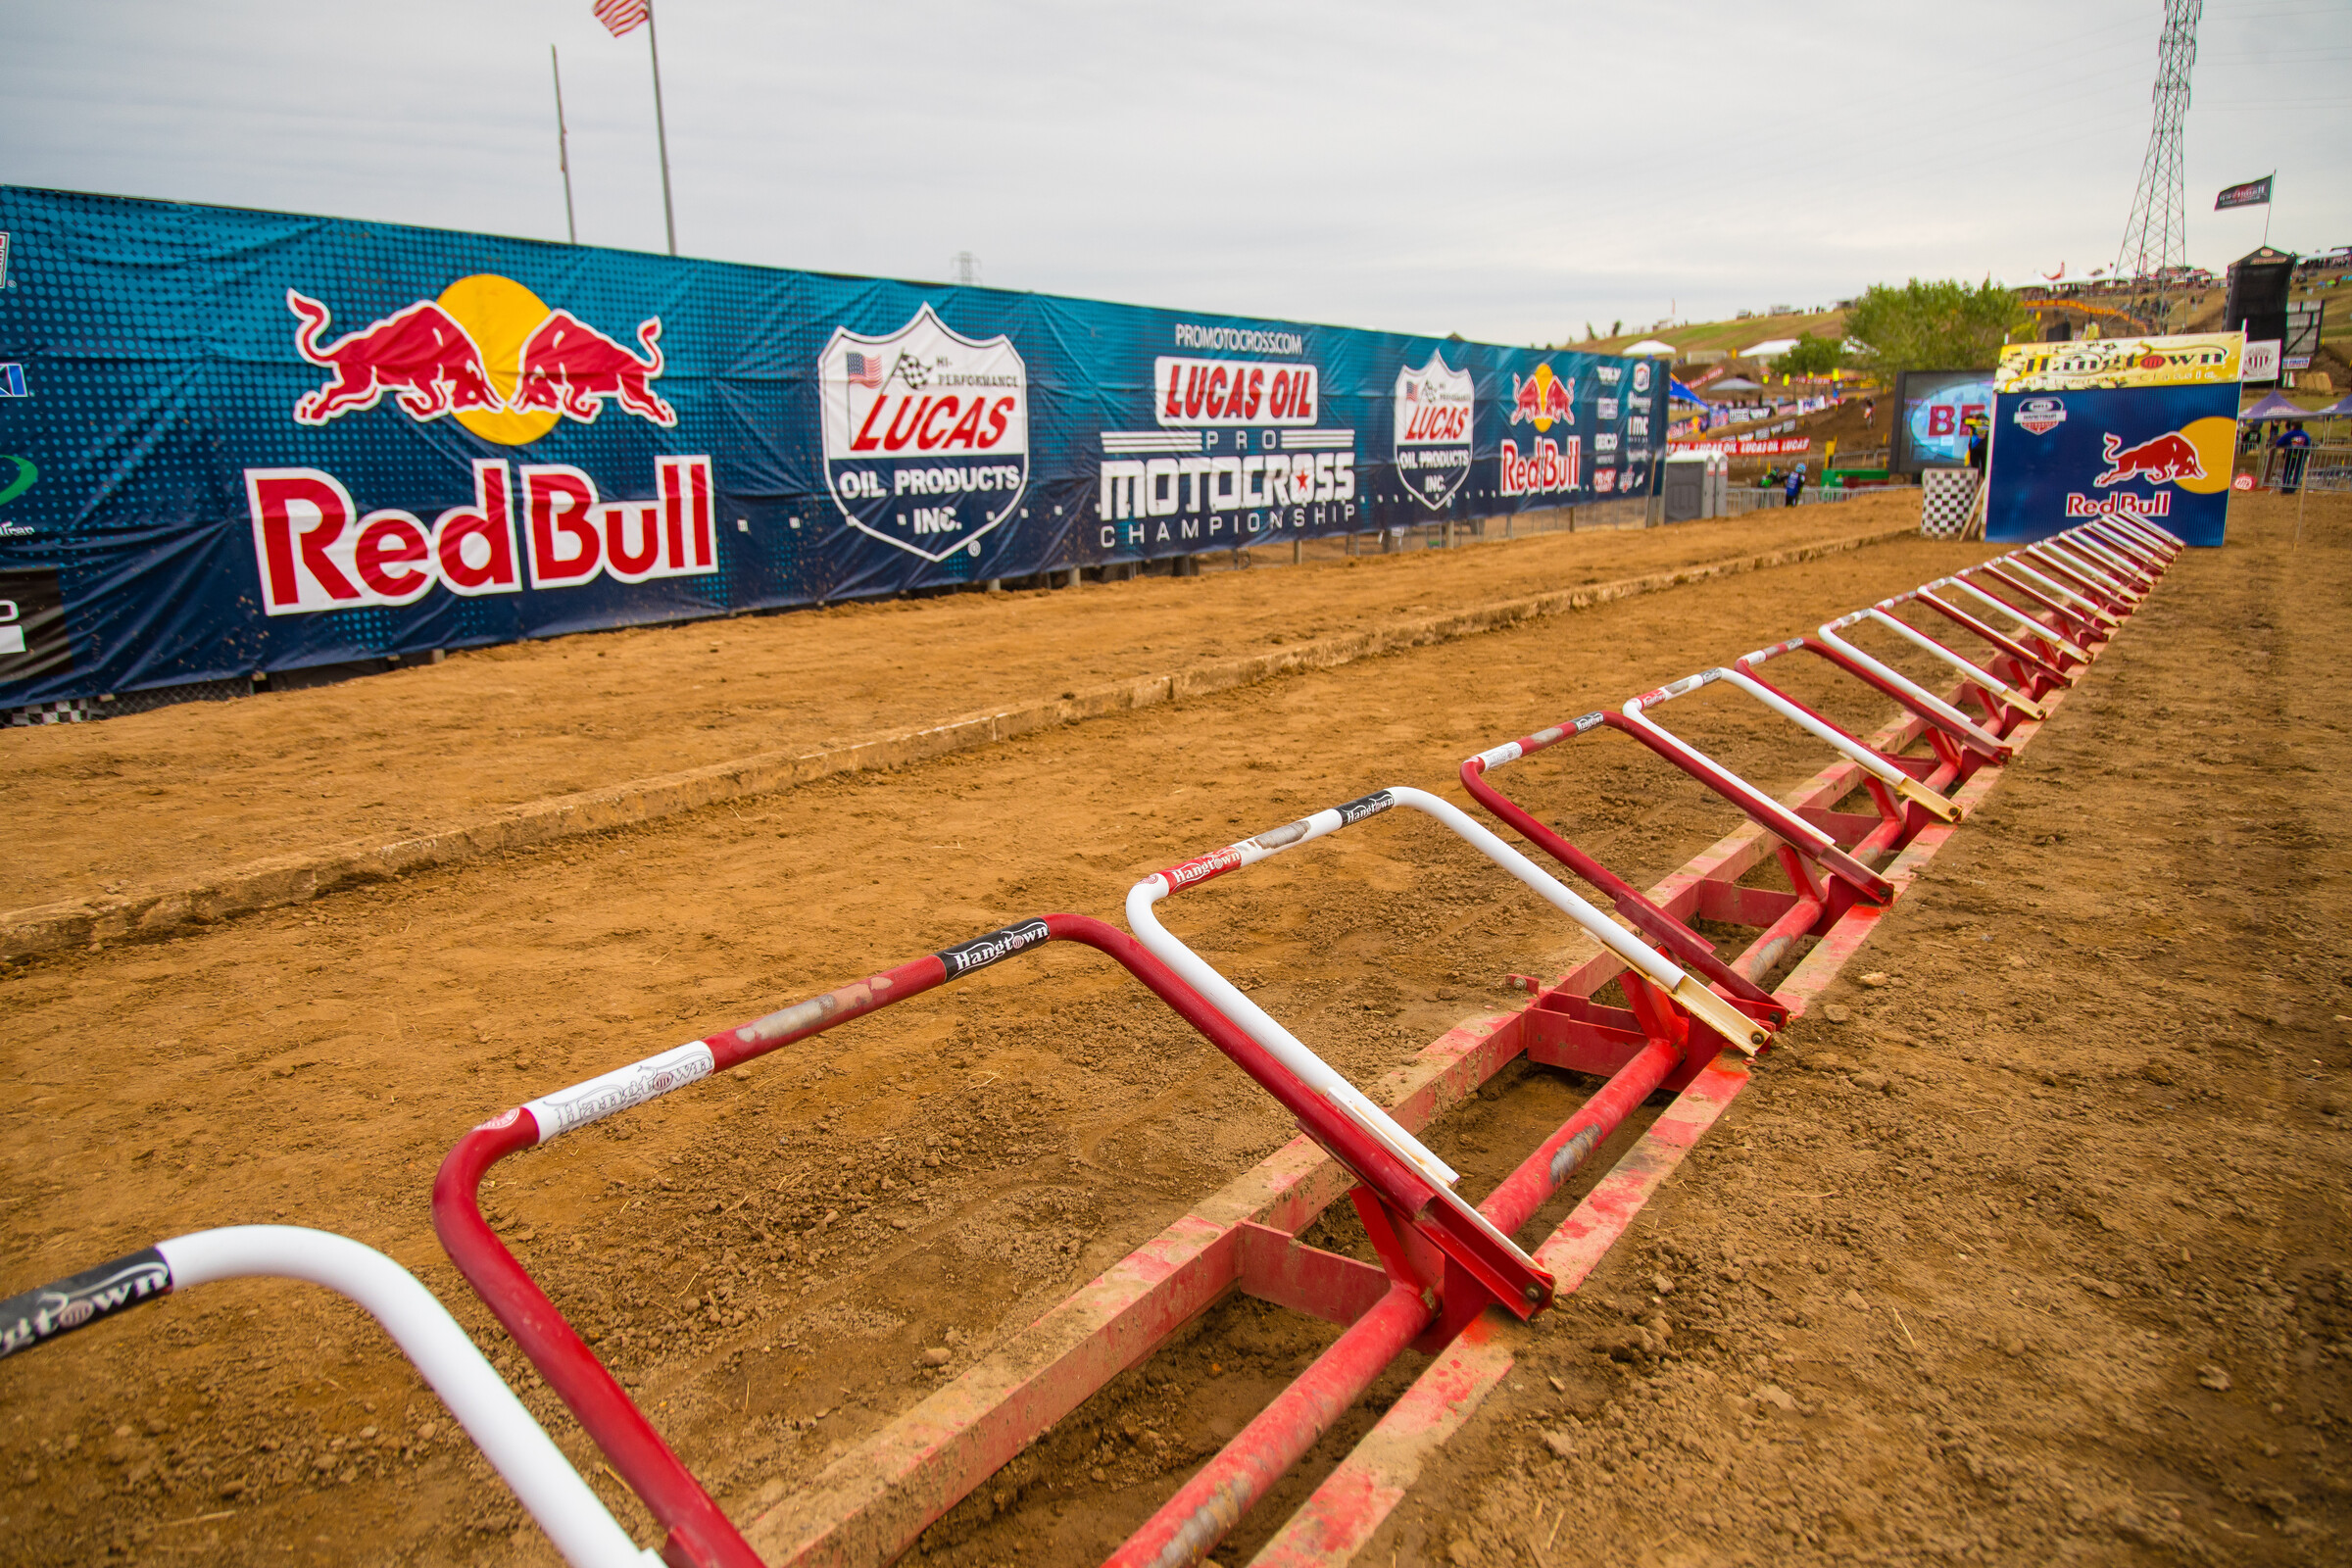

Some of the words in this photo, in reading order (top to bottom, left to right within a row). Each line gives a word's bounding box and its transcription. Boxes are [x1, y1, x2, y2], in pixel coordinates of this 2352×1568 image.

[1165, 365, 1263, 419] LUCAS
[1270, 369, 1312, 417] OIL
[851, 395, 1014, 451] LUCAS
[1206, 429, 1276, 450] PRO
[1405, 407, 1469, 440] LUCAS
[1399, 453, 1418, 469] OIL
[1420, 450, 1469, 467] PRODUCTS
[1782, 438, 1810, 451] LUCAS
[839, 471, 886, 499] OIL
[894, 465, 1019, 495] PRODUCTS
[1501, 437, 1542, 496] Red
[1543, 435, 1581, 491] Bull
[1101, 453, 1354, 520] MOTOCROSS
[1425, 475, 1446, 493] INC.
[913, 508, 961, 533] INC.
[2066, 491, 2119, 517] Red
[2119, 490, 2171, 516] Bull
[244, 458, 522, 615] Red
[520, 455, 719, 589] Bull
[1102, 504, 1355, 548] CHAMPIONSHIP
[1345, 796, 1395, 825] Hangtown
[1174, 847, 1241, 883] Hangtown
[952, 921, 1050, 972] Hangtown
[555, 1054, 714, 1129] Hangtown
